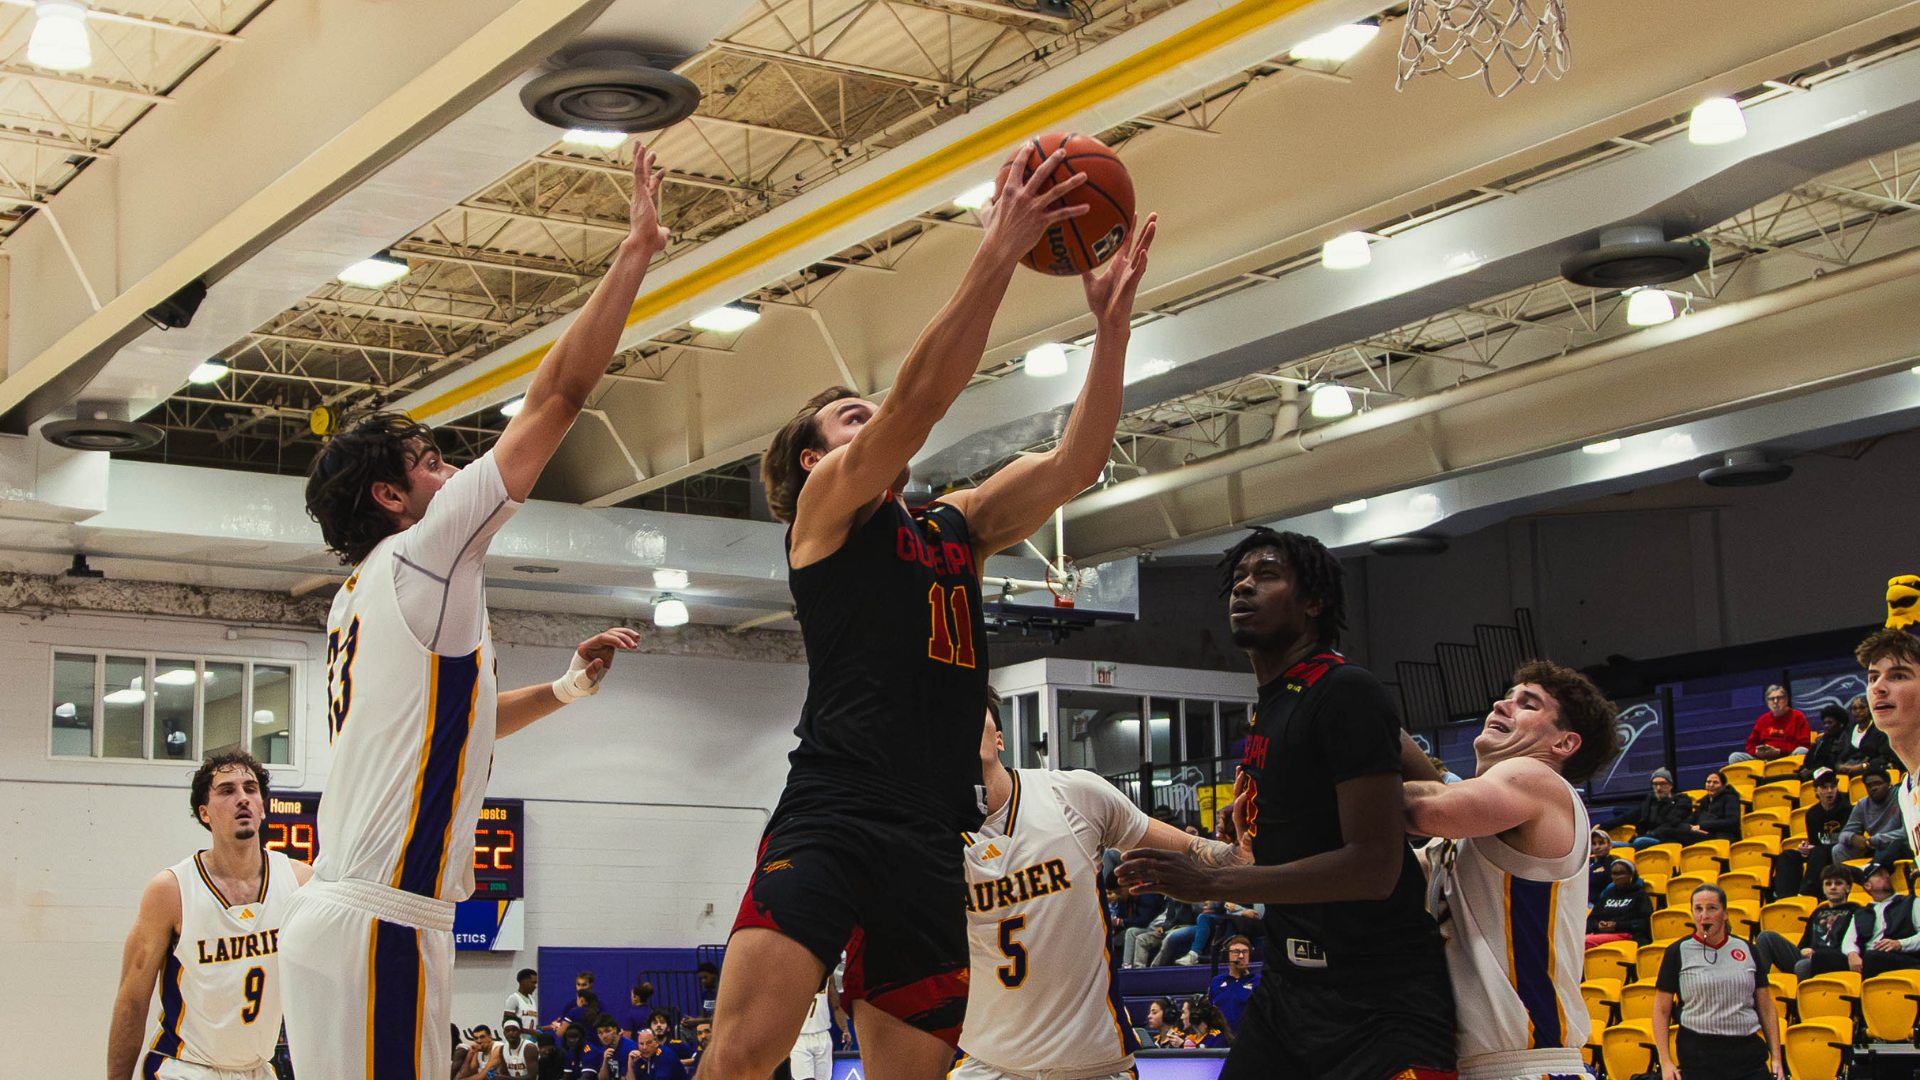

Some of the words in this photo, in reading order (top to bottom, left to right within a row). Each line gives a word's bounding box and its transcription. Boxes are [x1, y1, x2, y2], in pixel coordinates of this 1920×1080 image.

[928, 581, 976, 669] 11
[269, 798, 302, 814] Home
[478, 807, 507, 820] uests
[265, 823, 313, 866] 29
[964, 858, 1072, 914] AURIER
[197, 928, 280, 965] LAURIE
[455, 933, 487, 943] ETICS
[996, 913, 1029, 990] 5
[240, 965, 266, 1026] 9
